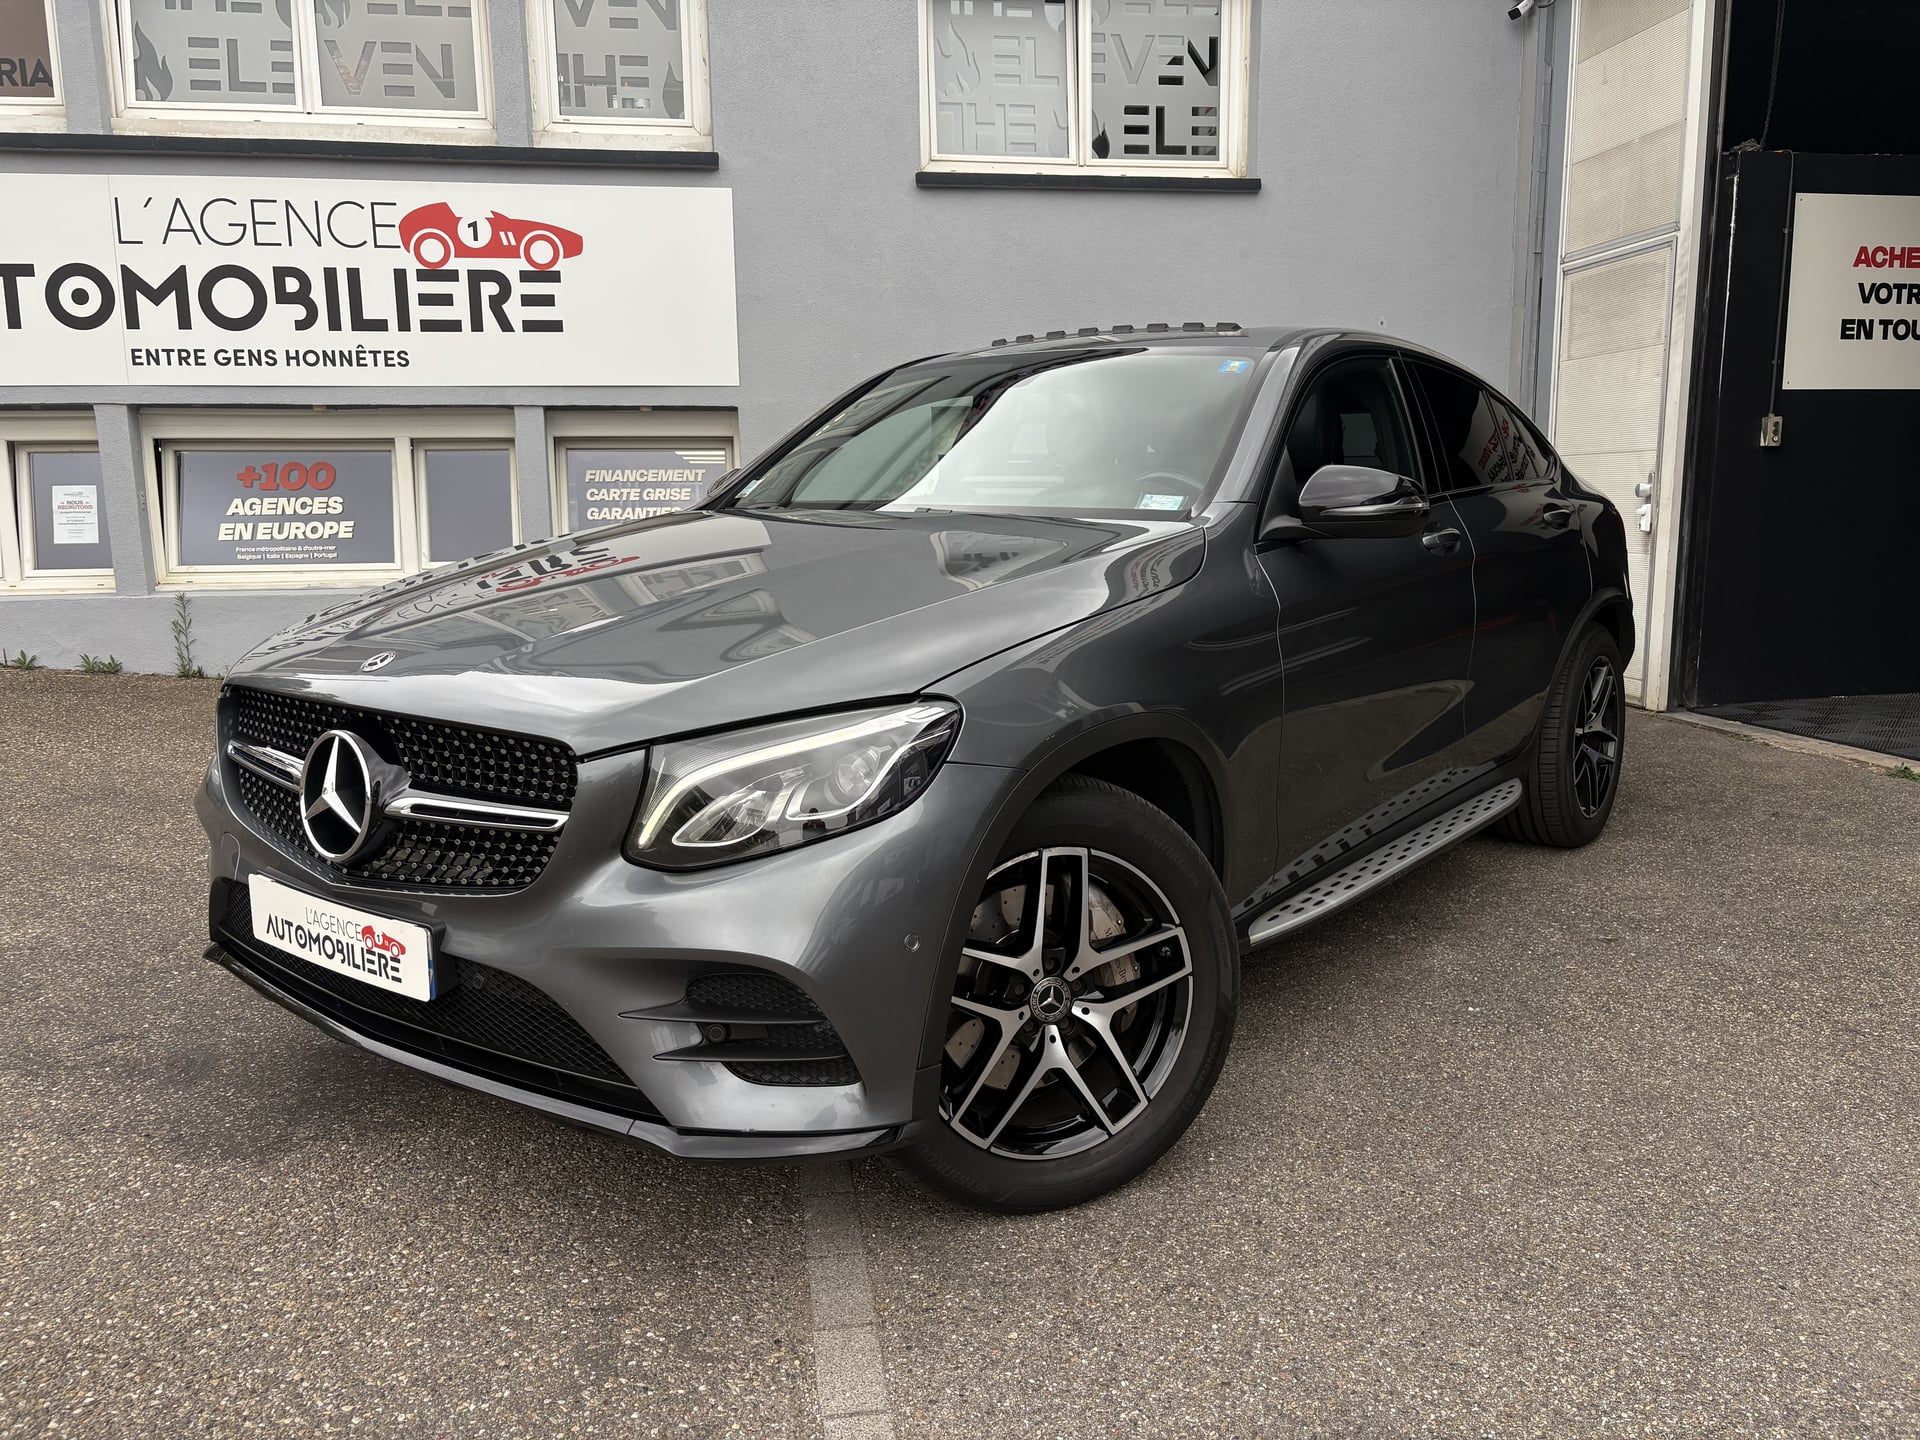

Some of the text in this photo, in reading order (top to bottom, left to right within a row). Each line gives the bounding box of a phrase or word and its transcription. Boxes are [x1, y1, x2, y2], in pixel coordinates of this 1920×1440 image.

[1124, 104, 1217, 156] ELE
[1853, 246, 1920, 269] ACHE
[1858, 282, 1920, 305] VOTR
[1840, 318, 1875, 340] EN
[130, 344, 411, 368] ENTRE GENS HONNÊTES
[236, 461, 336, 491] +100
[585, 469, 705, 482] FINANCEMENT
[586, 487, 691, 501] CARTE GRISE
[226, 497, 344, 516] AGENCES
[218, 521, 354, 541] EN EUROPE
[256, 545, 297, 553] métropolitaine
[285, 552, 309, 560] Espagne
[305, 907, 363, 942] L'AGENCE
